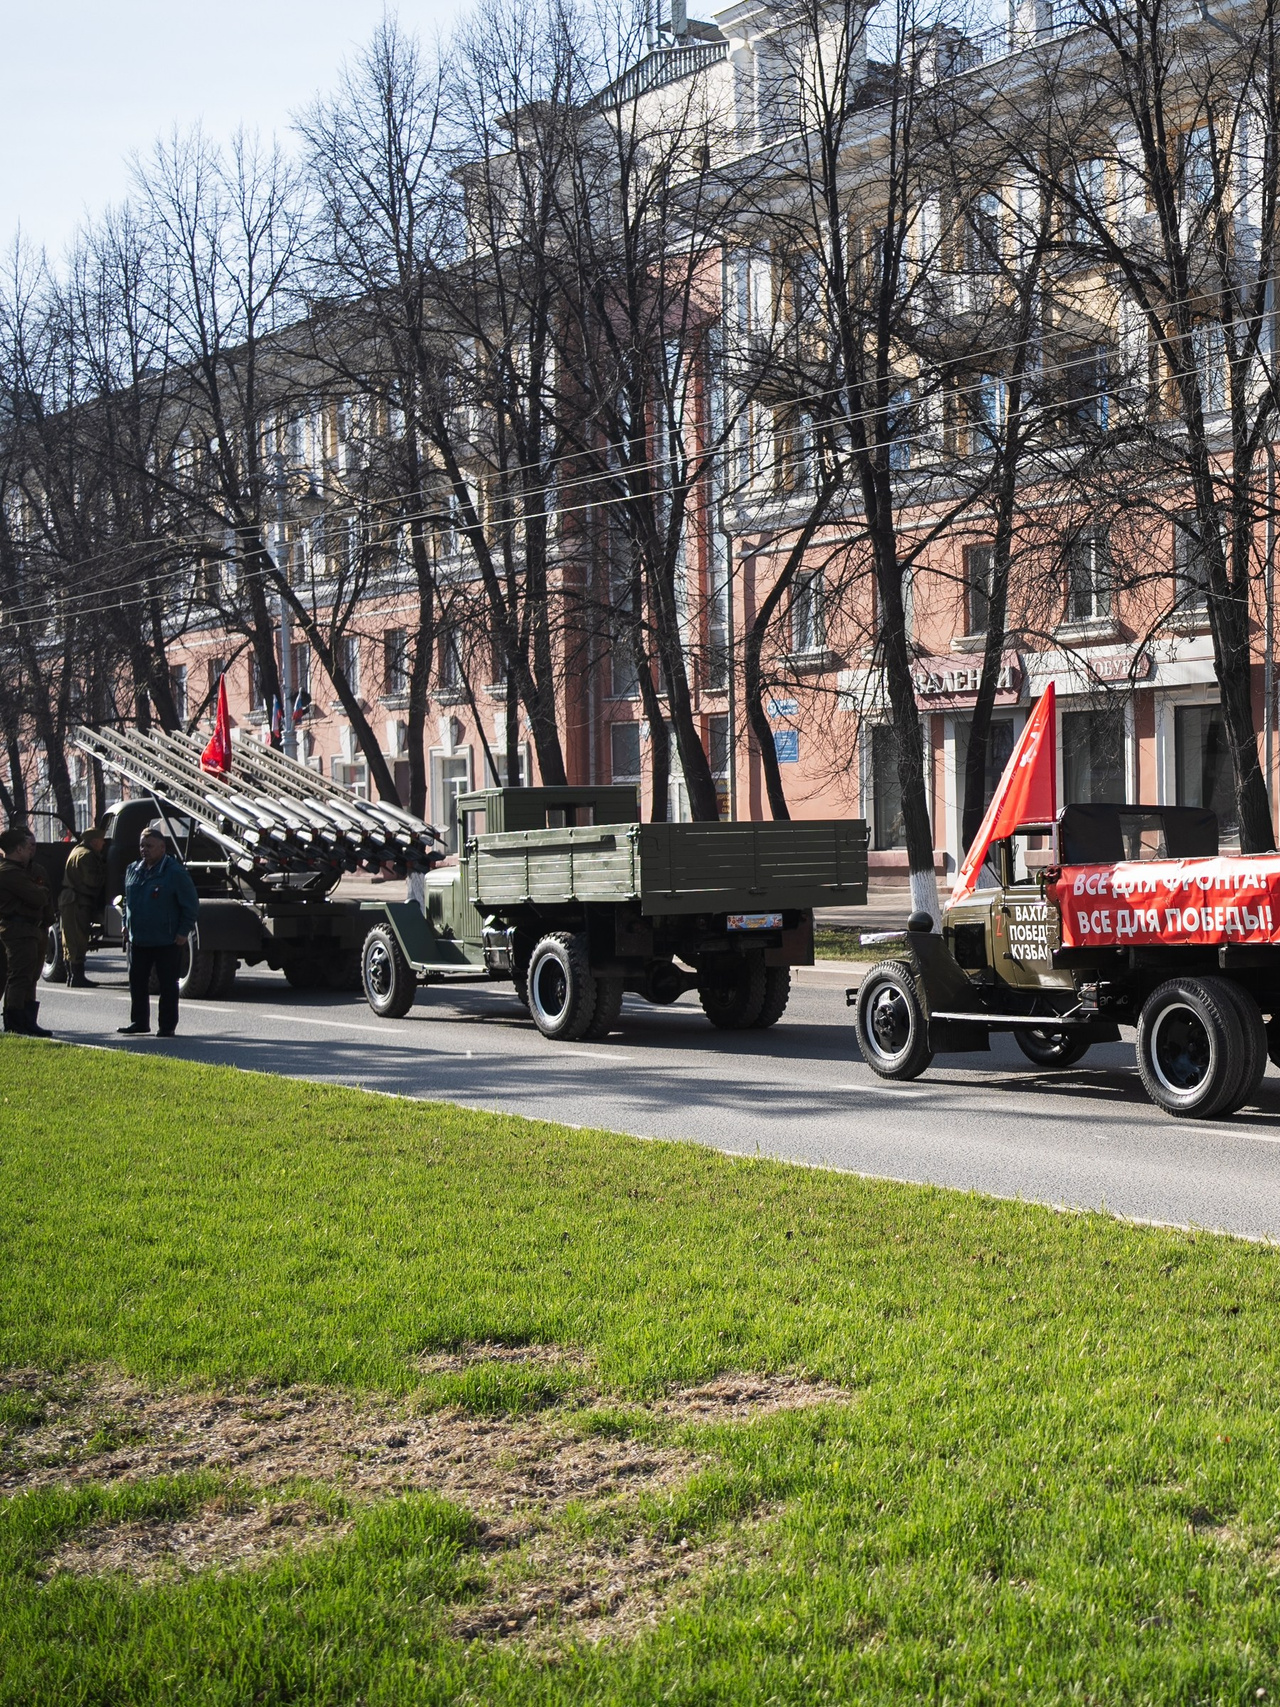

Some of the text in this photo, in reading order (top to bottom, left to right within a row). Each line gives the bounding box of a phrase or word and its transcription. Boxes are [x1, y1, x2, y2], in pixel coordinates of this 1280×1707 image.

[914, 666, 1012, 695] ВАЛЕНИ
[1073, 872, 1110, 896] ВСЕ
[1015, 905, 1048, 922] ВАХТА
[1077, 905, 1274, 938] ВСЕ ДЛЯ ПОБЕДЫ!
[1009, 924, 1048, 944] ПОБЕД
